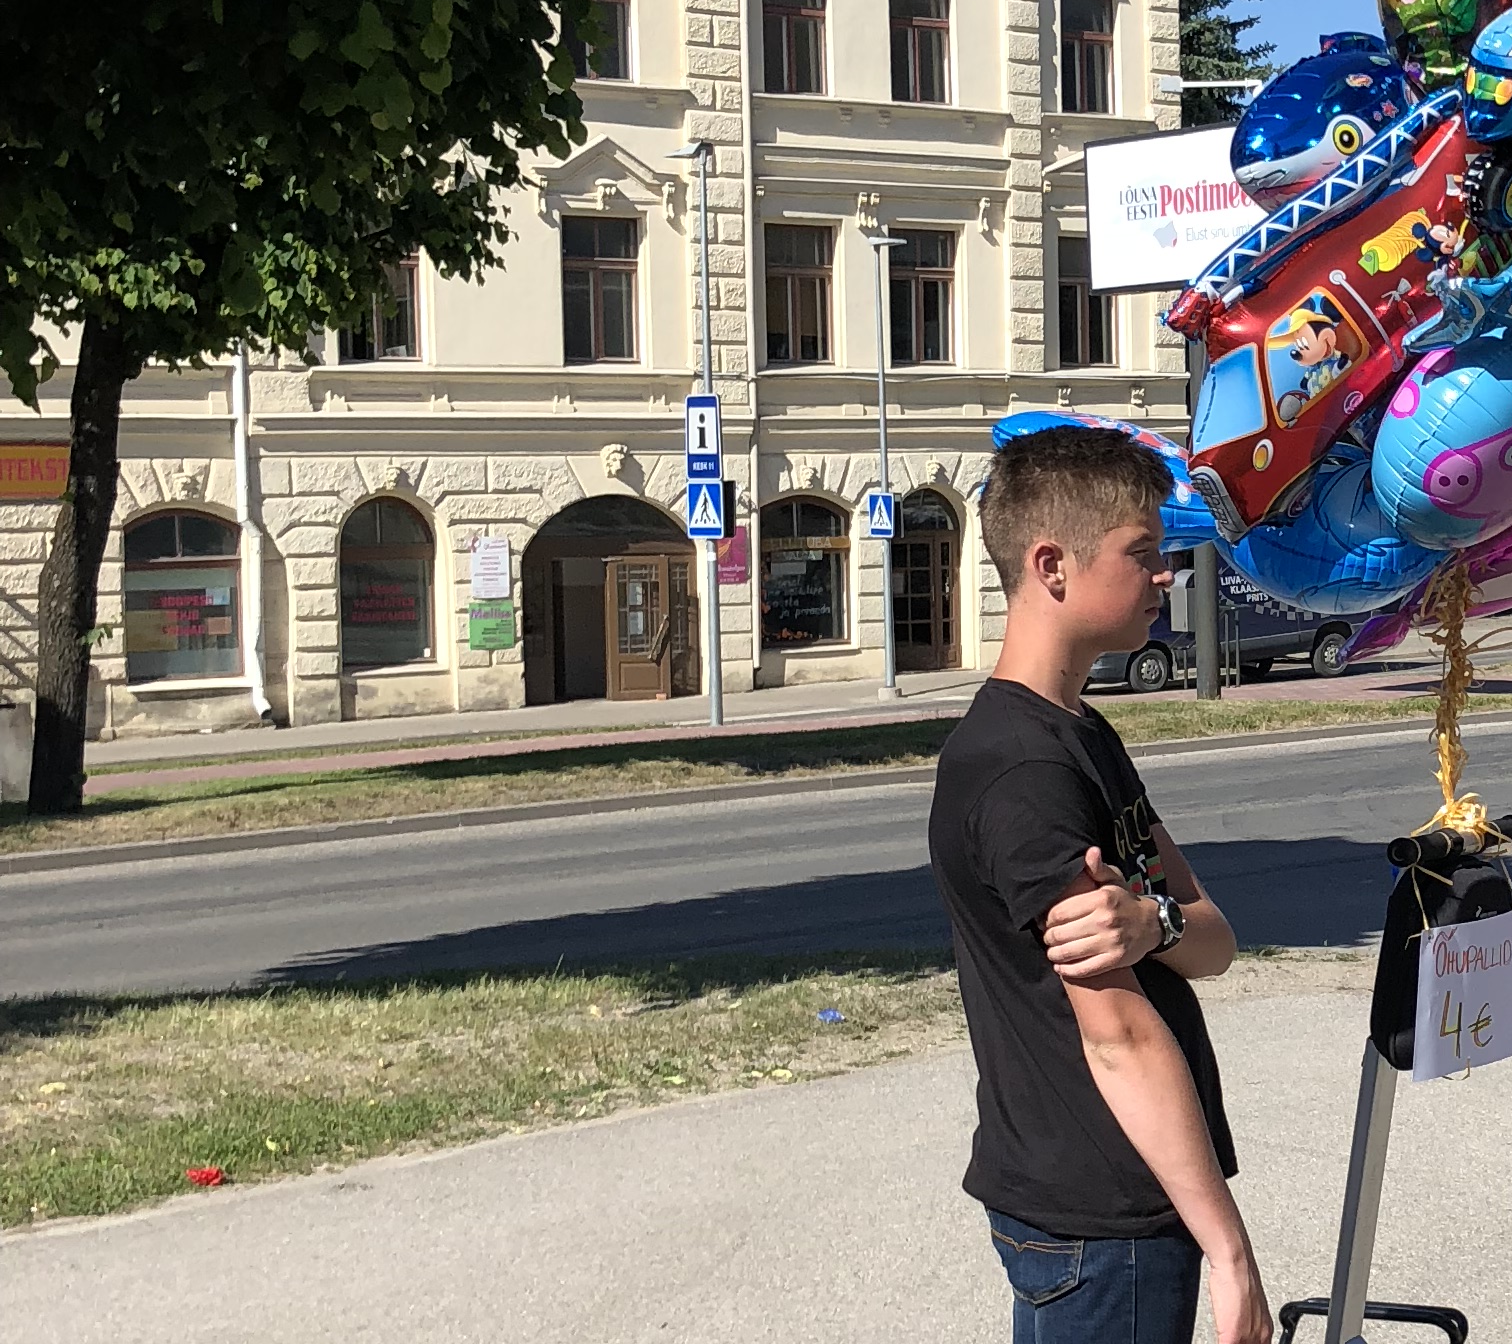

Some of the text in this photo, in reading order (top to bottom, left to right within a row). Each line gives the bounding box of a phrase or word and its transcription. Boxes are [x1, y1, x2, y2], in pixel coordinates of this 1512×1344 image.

[1119, 185, 1157, 205] LÕUNA
[1159, 179, 1256, 217] Postimee
[1126, 203, 1158, 221] EESTI
[1246, 593, 1268, 602] PRITS
[1433, 926, 1512, 978] ÕHUPALLID
